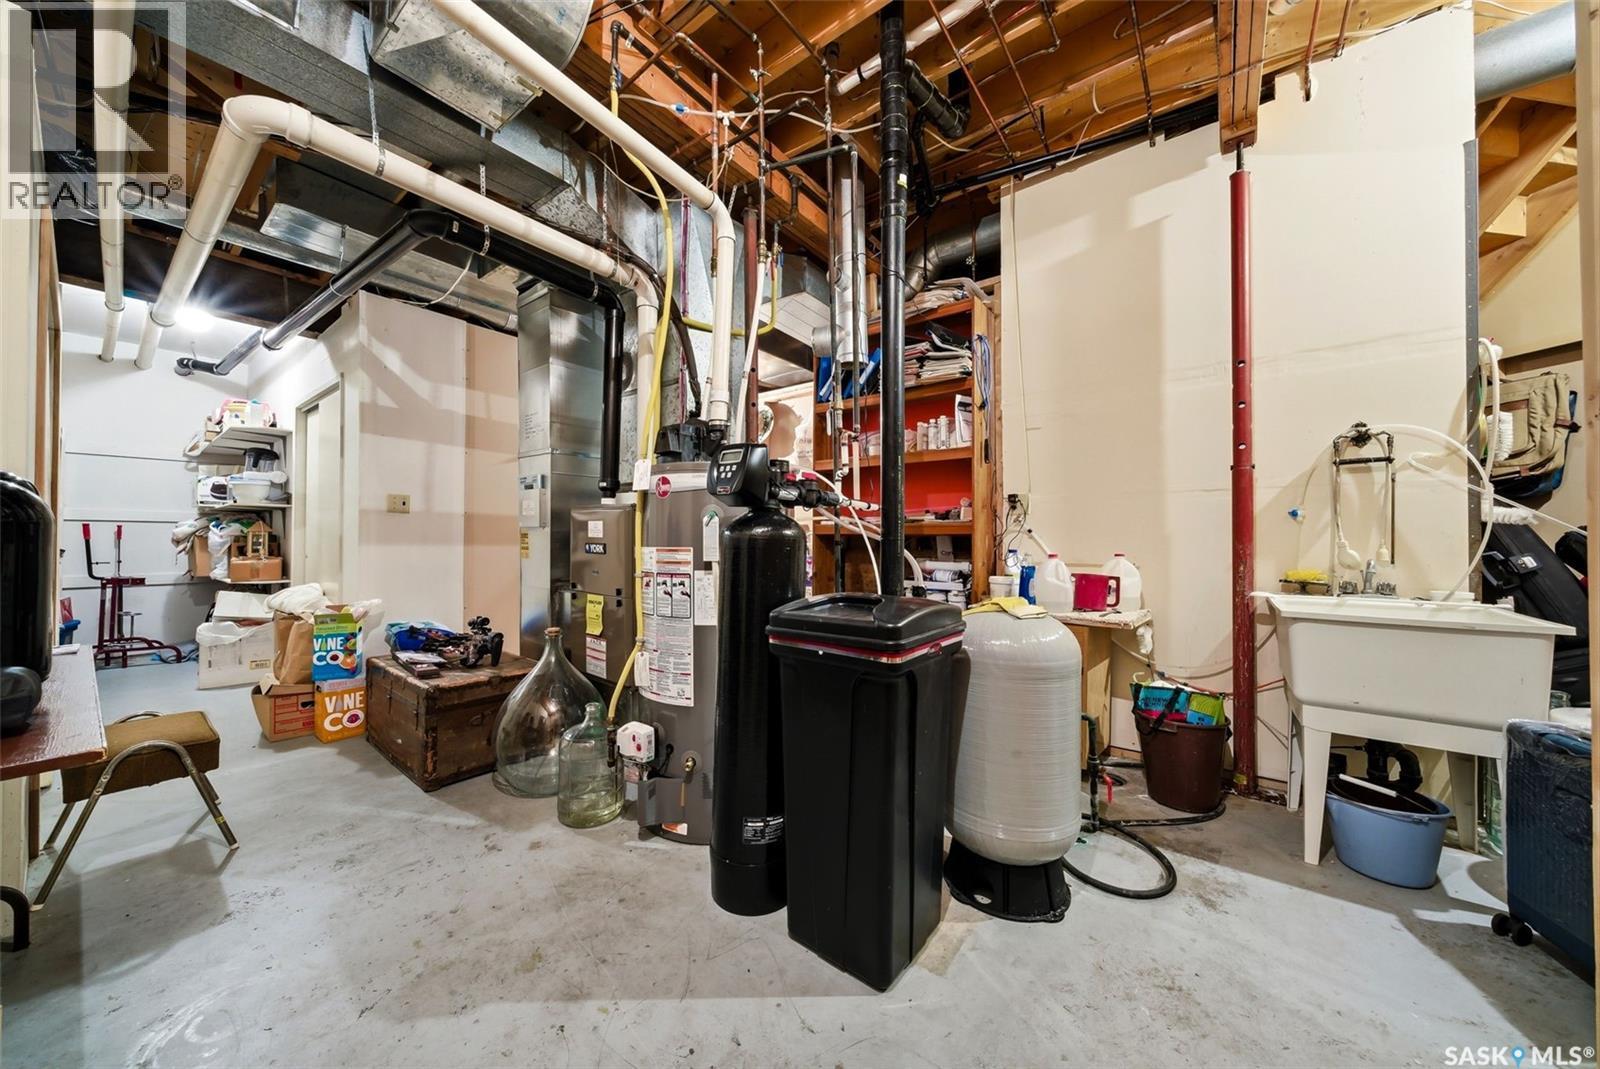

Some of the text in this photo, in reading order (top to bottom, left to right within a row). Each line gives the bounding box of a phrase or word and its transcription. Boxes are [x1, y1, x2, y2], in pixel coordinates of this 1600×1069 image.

[590, 544, 604, 553] YORK
[313, 636, 345, 651] VINE
[312, 651, 345, 666] CO
[324, 691, 365, 713] VINE
[323, 709, 365, 732] CO
